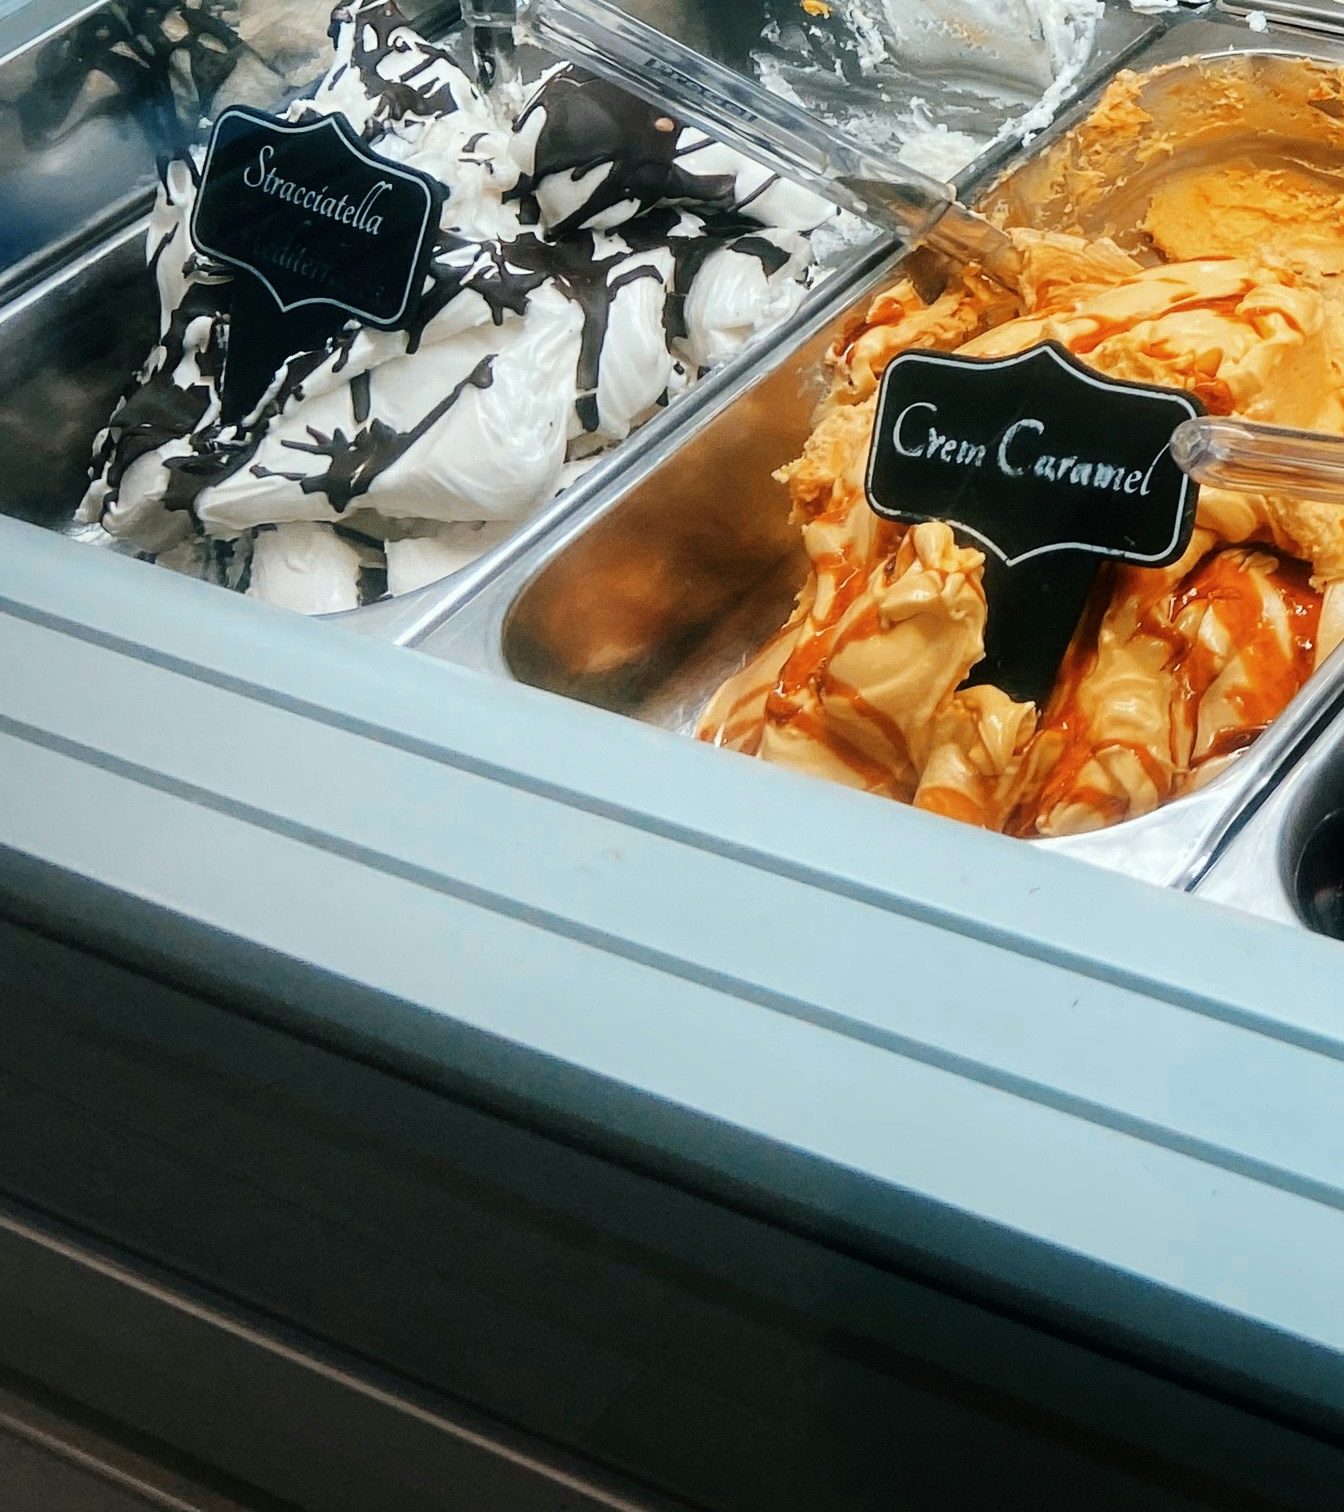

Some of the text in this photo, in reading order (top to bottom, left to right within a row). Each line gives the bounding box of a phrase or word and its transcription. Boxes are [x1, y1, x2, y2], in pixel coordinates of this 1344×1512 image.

[243, 145, 393, 235] Stracciatella
[893, 402, 1172, 496] Crem Caramel
